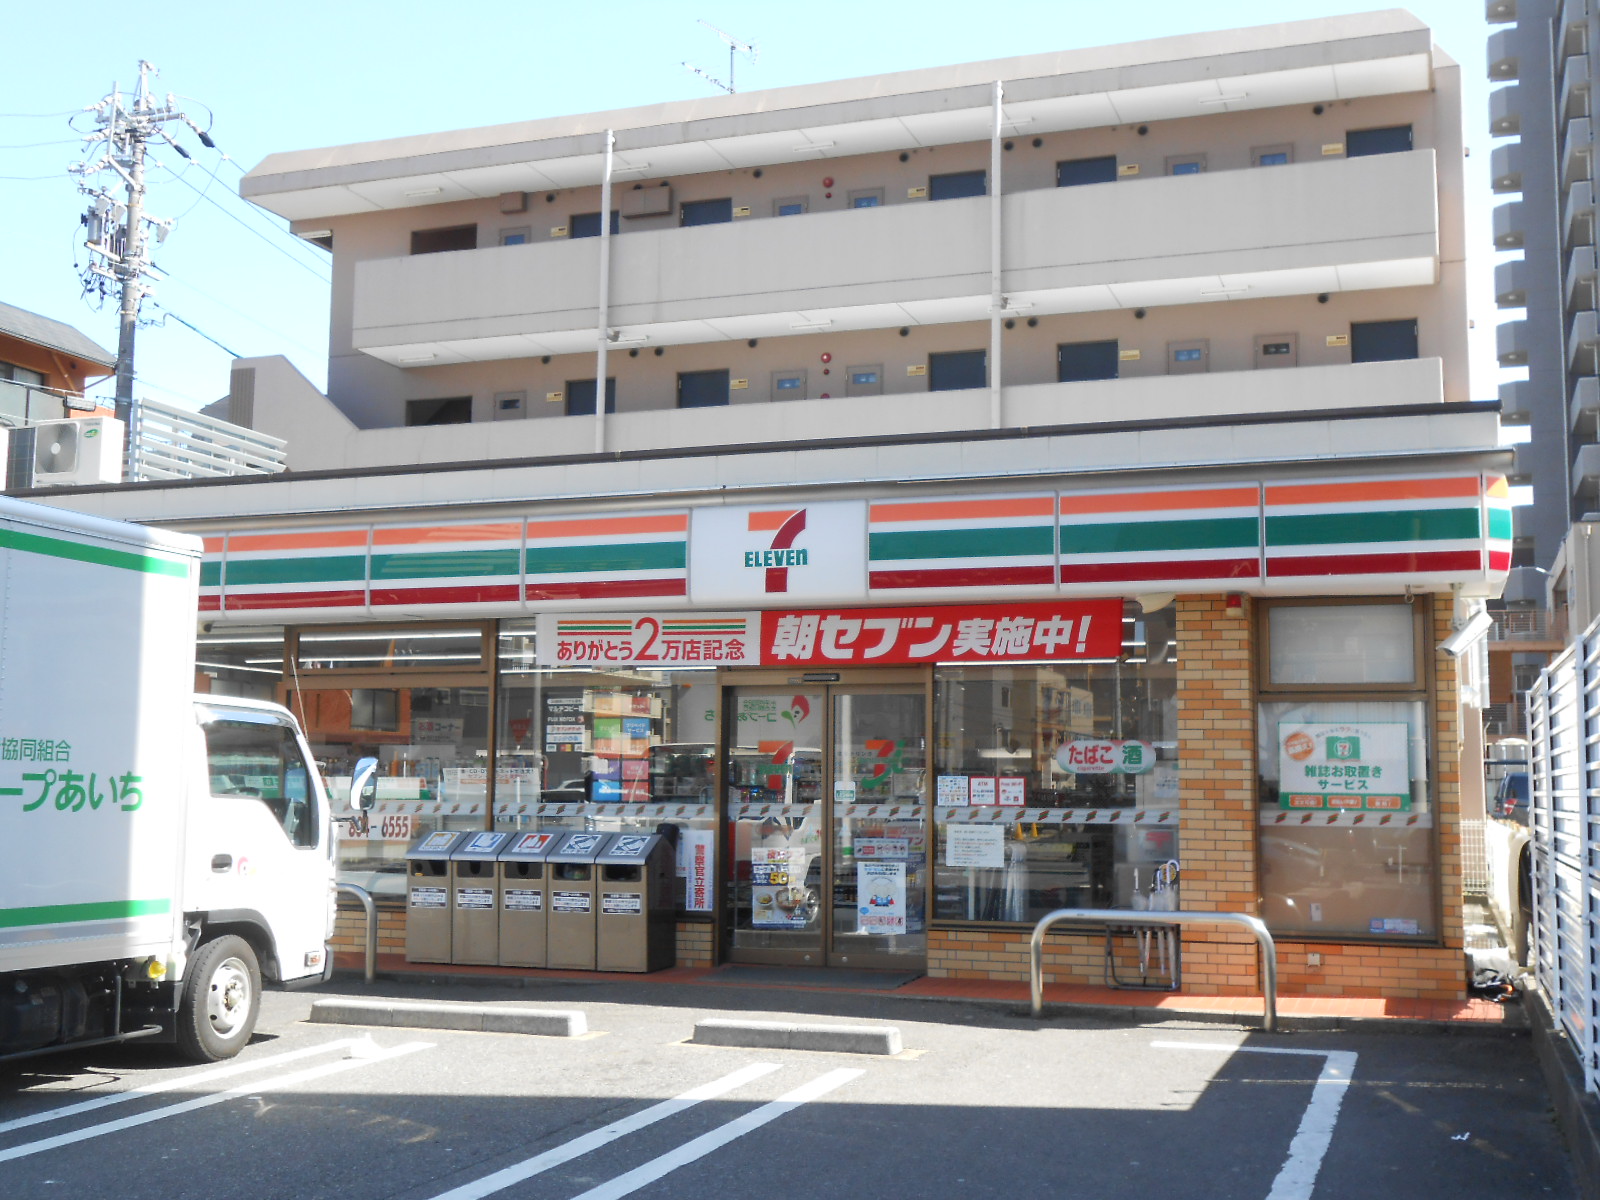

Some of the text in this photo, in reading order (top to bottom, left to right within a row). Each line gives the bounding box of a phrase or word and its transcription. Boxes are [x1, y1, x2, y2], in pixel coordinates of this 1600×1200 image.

[557, 616, 746, 661] ありがとう2万店記念
[771, 613, 1092, 660] 朝セブン実施中!
[2, 738, 71, 762] 協同組合
[1068, 744, 1143, 765] たばこ 酒
[1304, 764, 1382, 778] 雑誌お取置き
[1318, 779, 1368, 790] サービス
